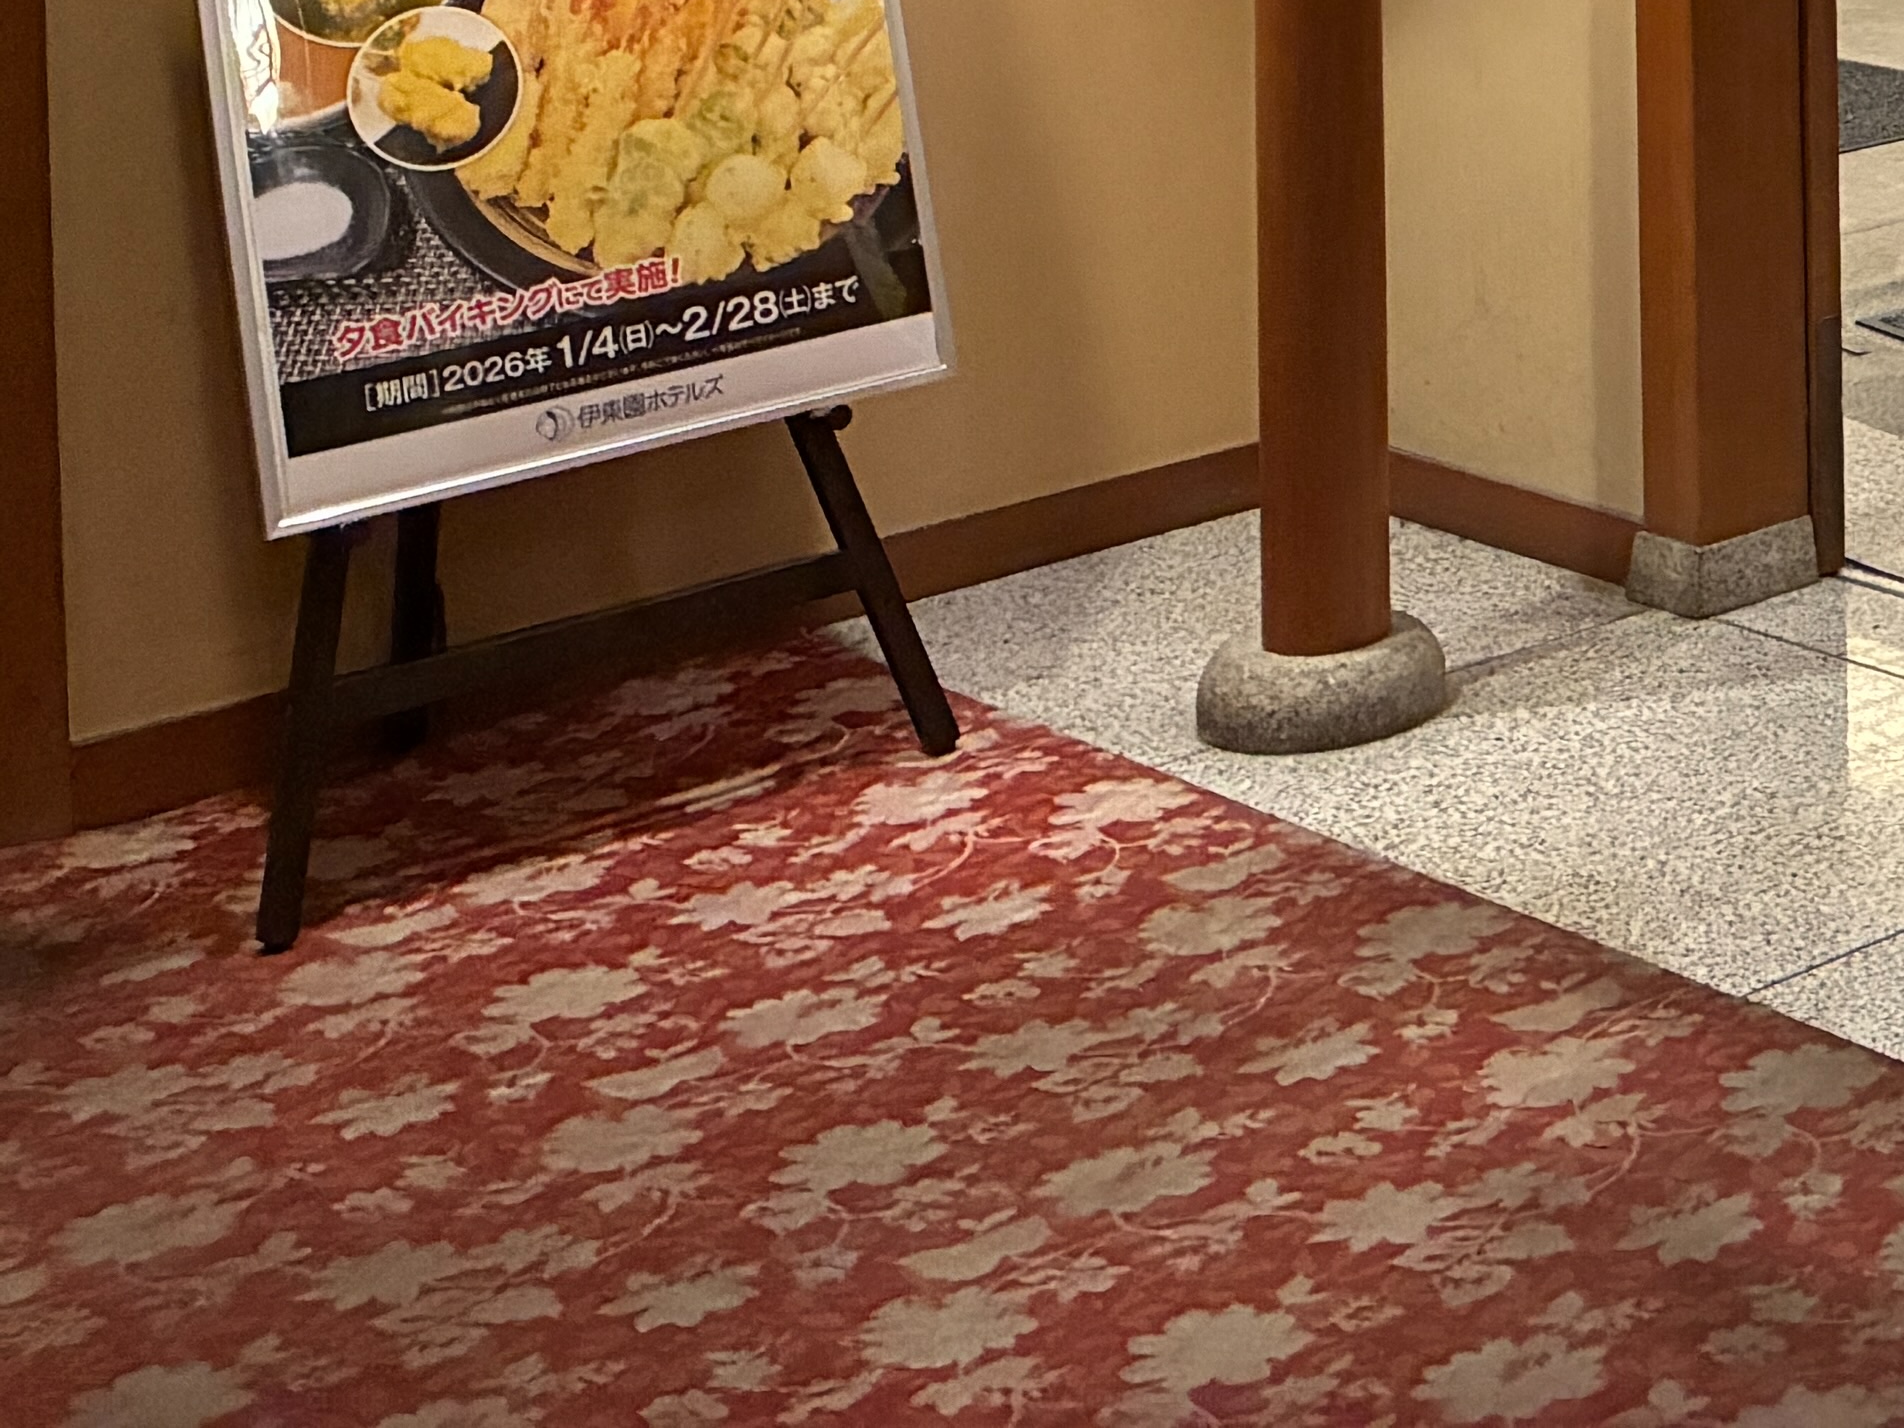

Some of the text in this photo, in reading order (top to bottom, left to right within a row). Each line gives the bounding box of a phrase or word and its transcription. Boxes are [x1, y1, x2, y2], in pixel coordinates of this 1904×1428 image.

[577, 374, 725, 430] 伊東園ホテルズ
